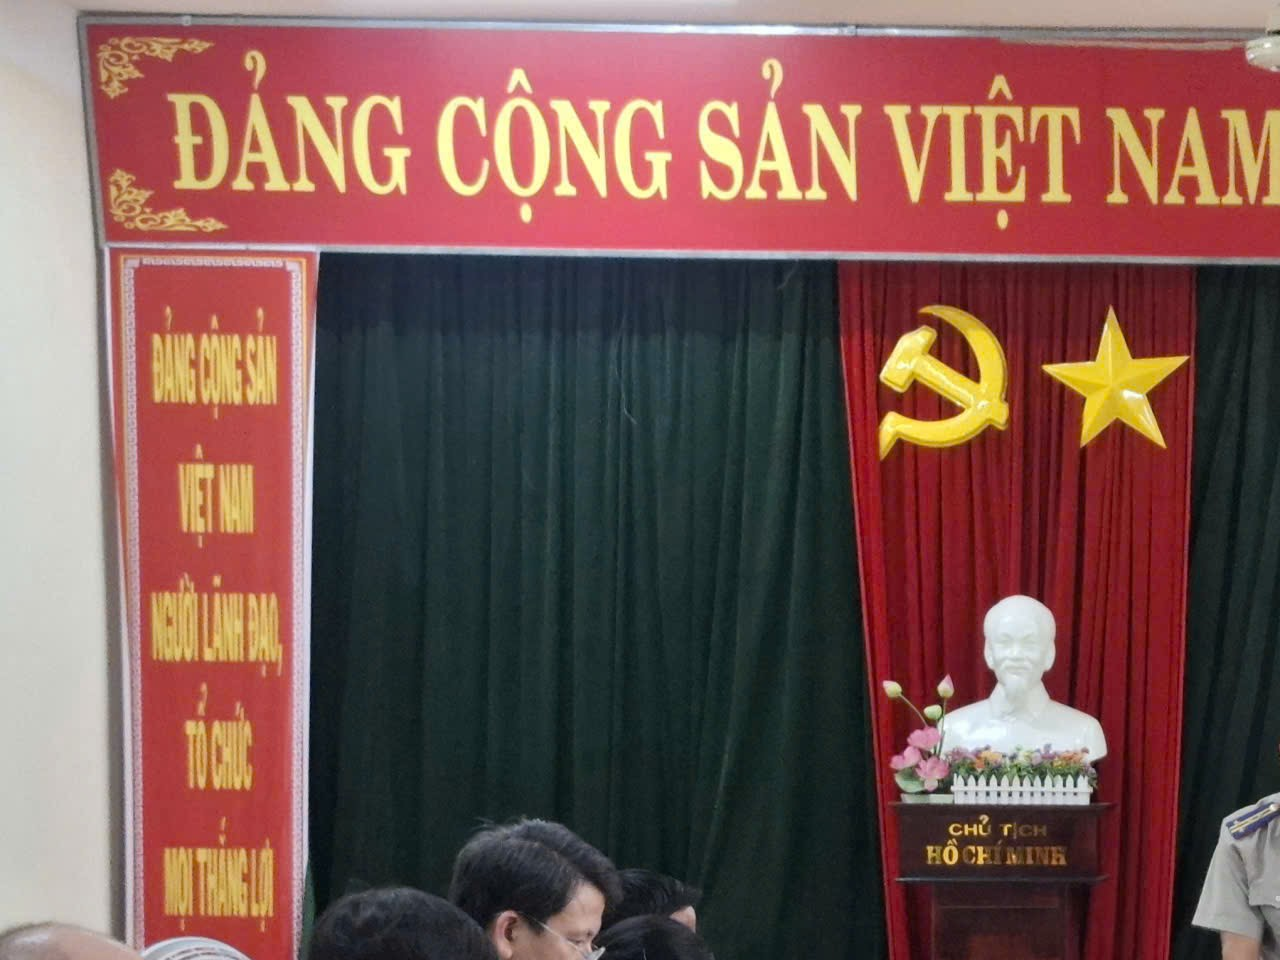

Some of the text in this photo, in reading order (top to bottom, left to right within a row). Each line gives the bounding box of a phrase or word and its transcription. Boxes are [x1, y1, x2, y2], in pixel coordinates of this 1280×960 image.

[166, 50, 411, 196] ĐẢNG
[436, 67, 672, 224] CỘNG
[698, 57, 862, 201] SẢN
[884, 76, 1080, 229] VIỆT
[153, 306, 277, 420] ĐẢNG CỘNG SẢN
[178, 443, 254, 548] VIỆT NAM
[926, 838, 1068, 866] HỒ CHÍ MINH
[948, 814, 991, 837] CHỦ
